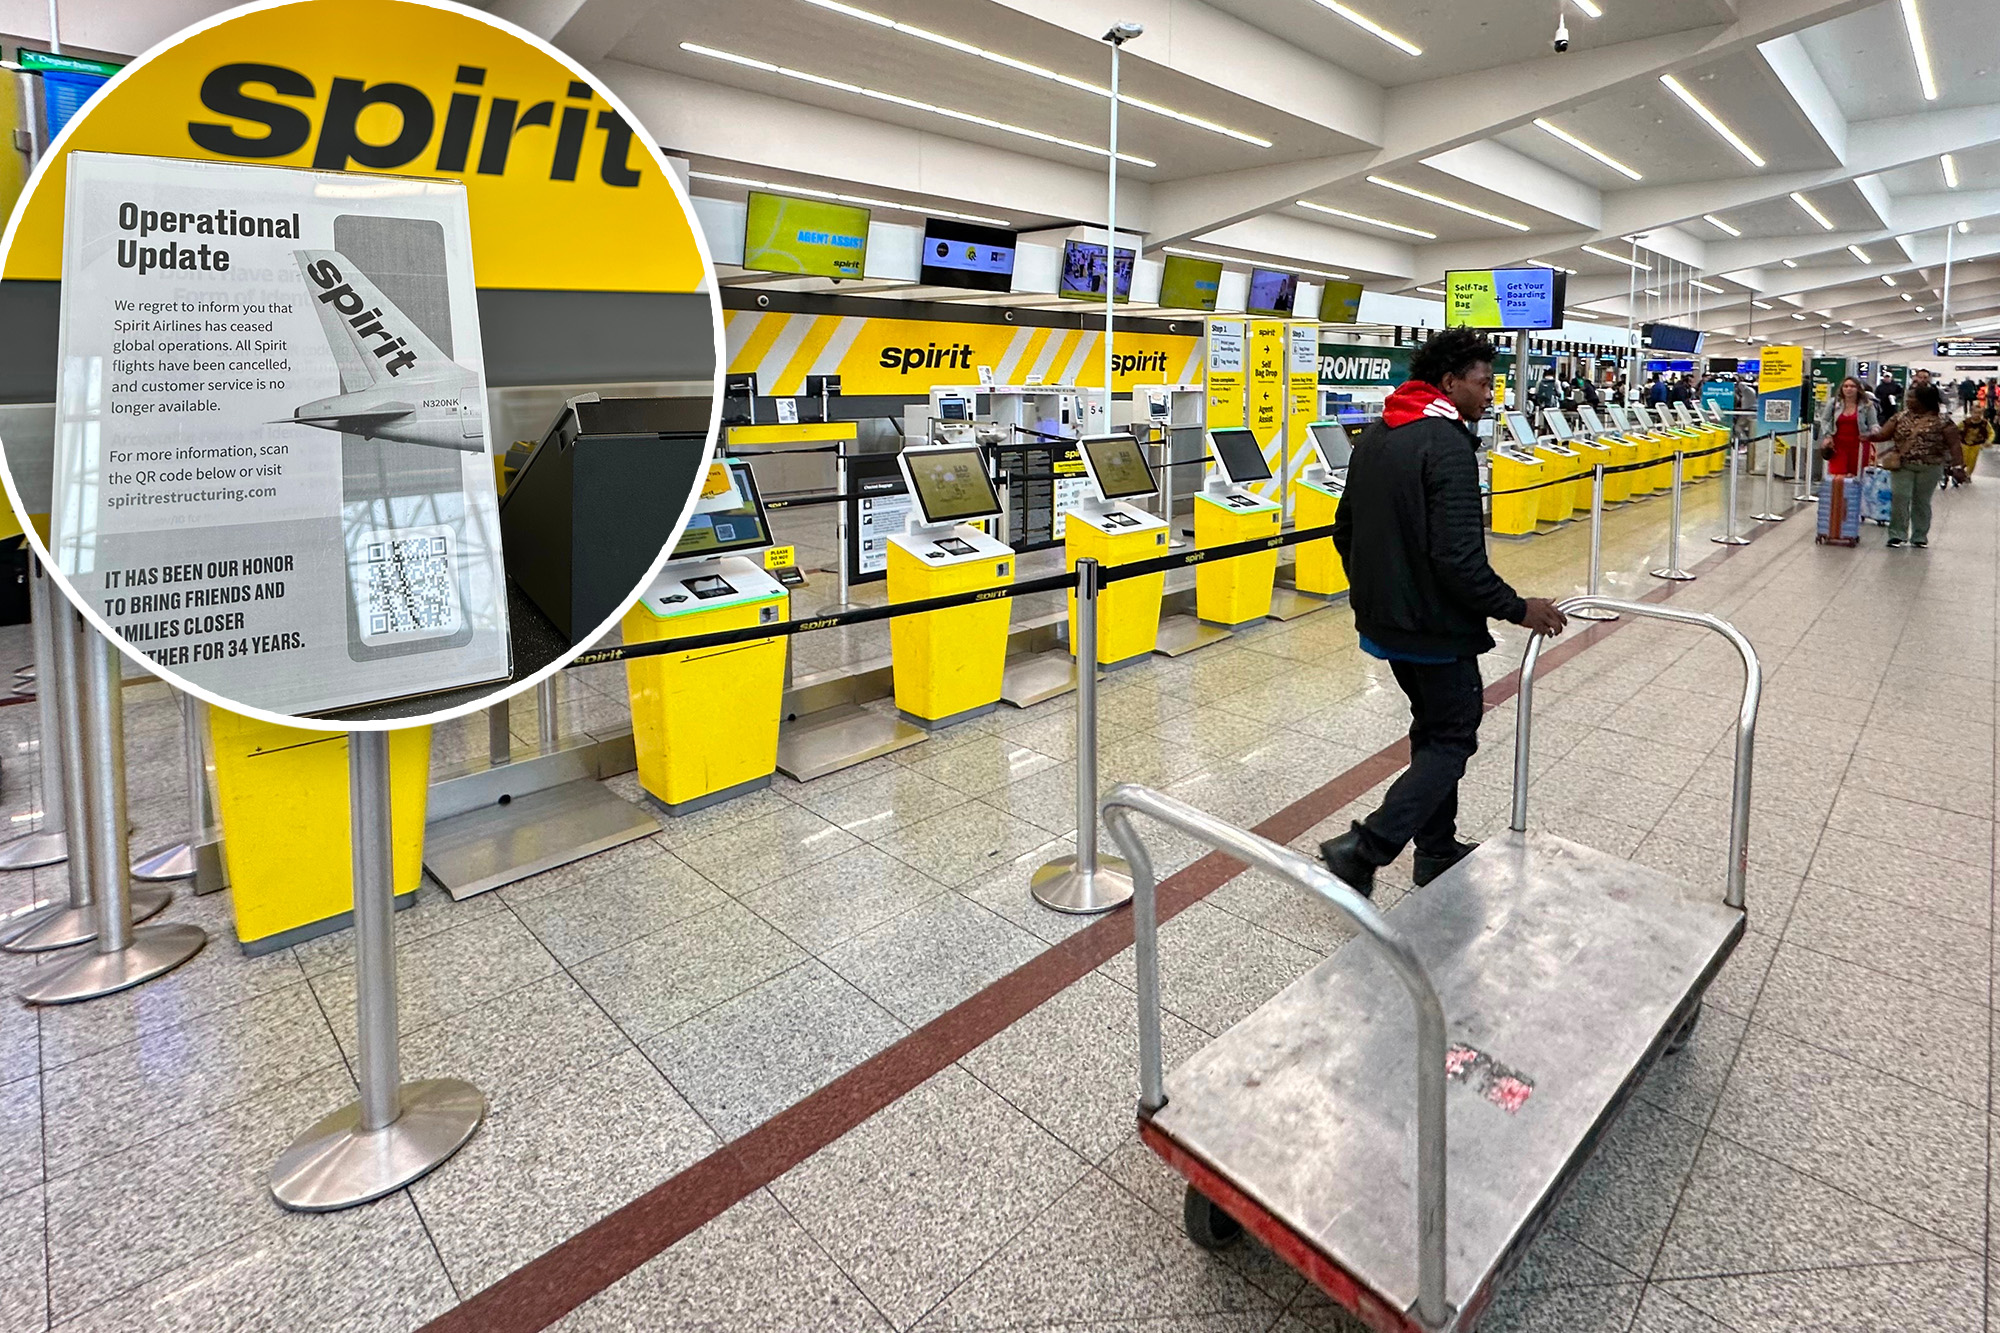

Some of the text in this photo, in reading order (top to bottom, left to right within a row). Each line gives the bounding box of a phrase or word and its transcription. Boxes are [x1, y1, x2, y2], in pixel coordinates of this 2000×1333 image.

[187, 61, 643, 188] spirit
[118, 201, 300, 240] Operational
[797, 230, 864, 250] AGENT ASSIST
[117, 239, 230, 276] Update
[833, 260, 860, 269] spirit
[1454, 283, 1489, 292] Self-Tag
[1507, 282, 1544, 290] Get Your
[1454, 292, 1474, 300] Your
[1507, 291, 1546, 300] Boarding
[114, 300, 293, 315] We regret to inform you that
[1454, 300, 1471, 309] Bag
[306, 258, 418, 378] spirit
[114, 320, 273, 333] Spirit Airlines has ceased
[1211, 324, 1228, 333] Step 1
[113, 339, 287, 354] global operations. All Spirit
[879, 342, 973, 375] spirit
[1111, 351, 1168, 377] spirit
[1261, 360, 1271, 368] Self
[112, 358, 292, 375] flights have been cancelled,
[1255, 369, 1278, 378] Bag Drop
[1859, 362, 1869, 371] 2
[112, 378, 285, 392] and customer service is no
[111, 400, 221, 416] longer available.
[422, 398, 460, 409] N320NK
[1090, 405, 1096, 415] 5
[1258, 405, 1273, 415] Agent
[1258, 415, 1273, 423] Assist
[110, 444, 289, 463] For more information, scan
[108, 464, 282, 486] the QR code below or visit
[108, 487, 277, 509] spiritrestructuring.com
[1267, 536, 1284, 547] spirit
[1185, 551, 1205, 564] spirit
[105, 554, 294, 589] IT HAS BEEN OUR HONOR
[104, 581, 285, 617] TO BRING FRIENDS AND
[976, 589, 1008, 601] spirit
[110, 611, 245, 643] AMILIES CLOSER
[799, 617, 839, 631] spirit
[193, 641, 225, 663] FOR
[228, 637, 249, 657] 34
[251, 631, 306, 655] YEARS.
